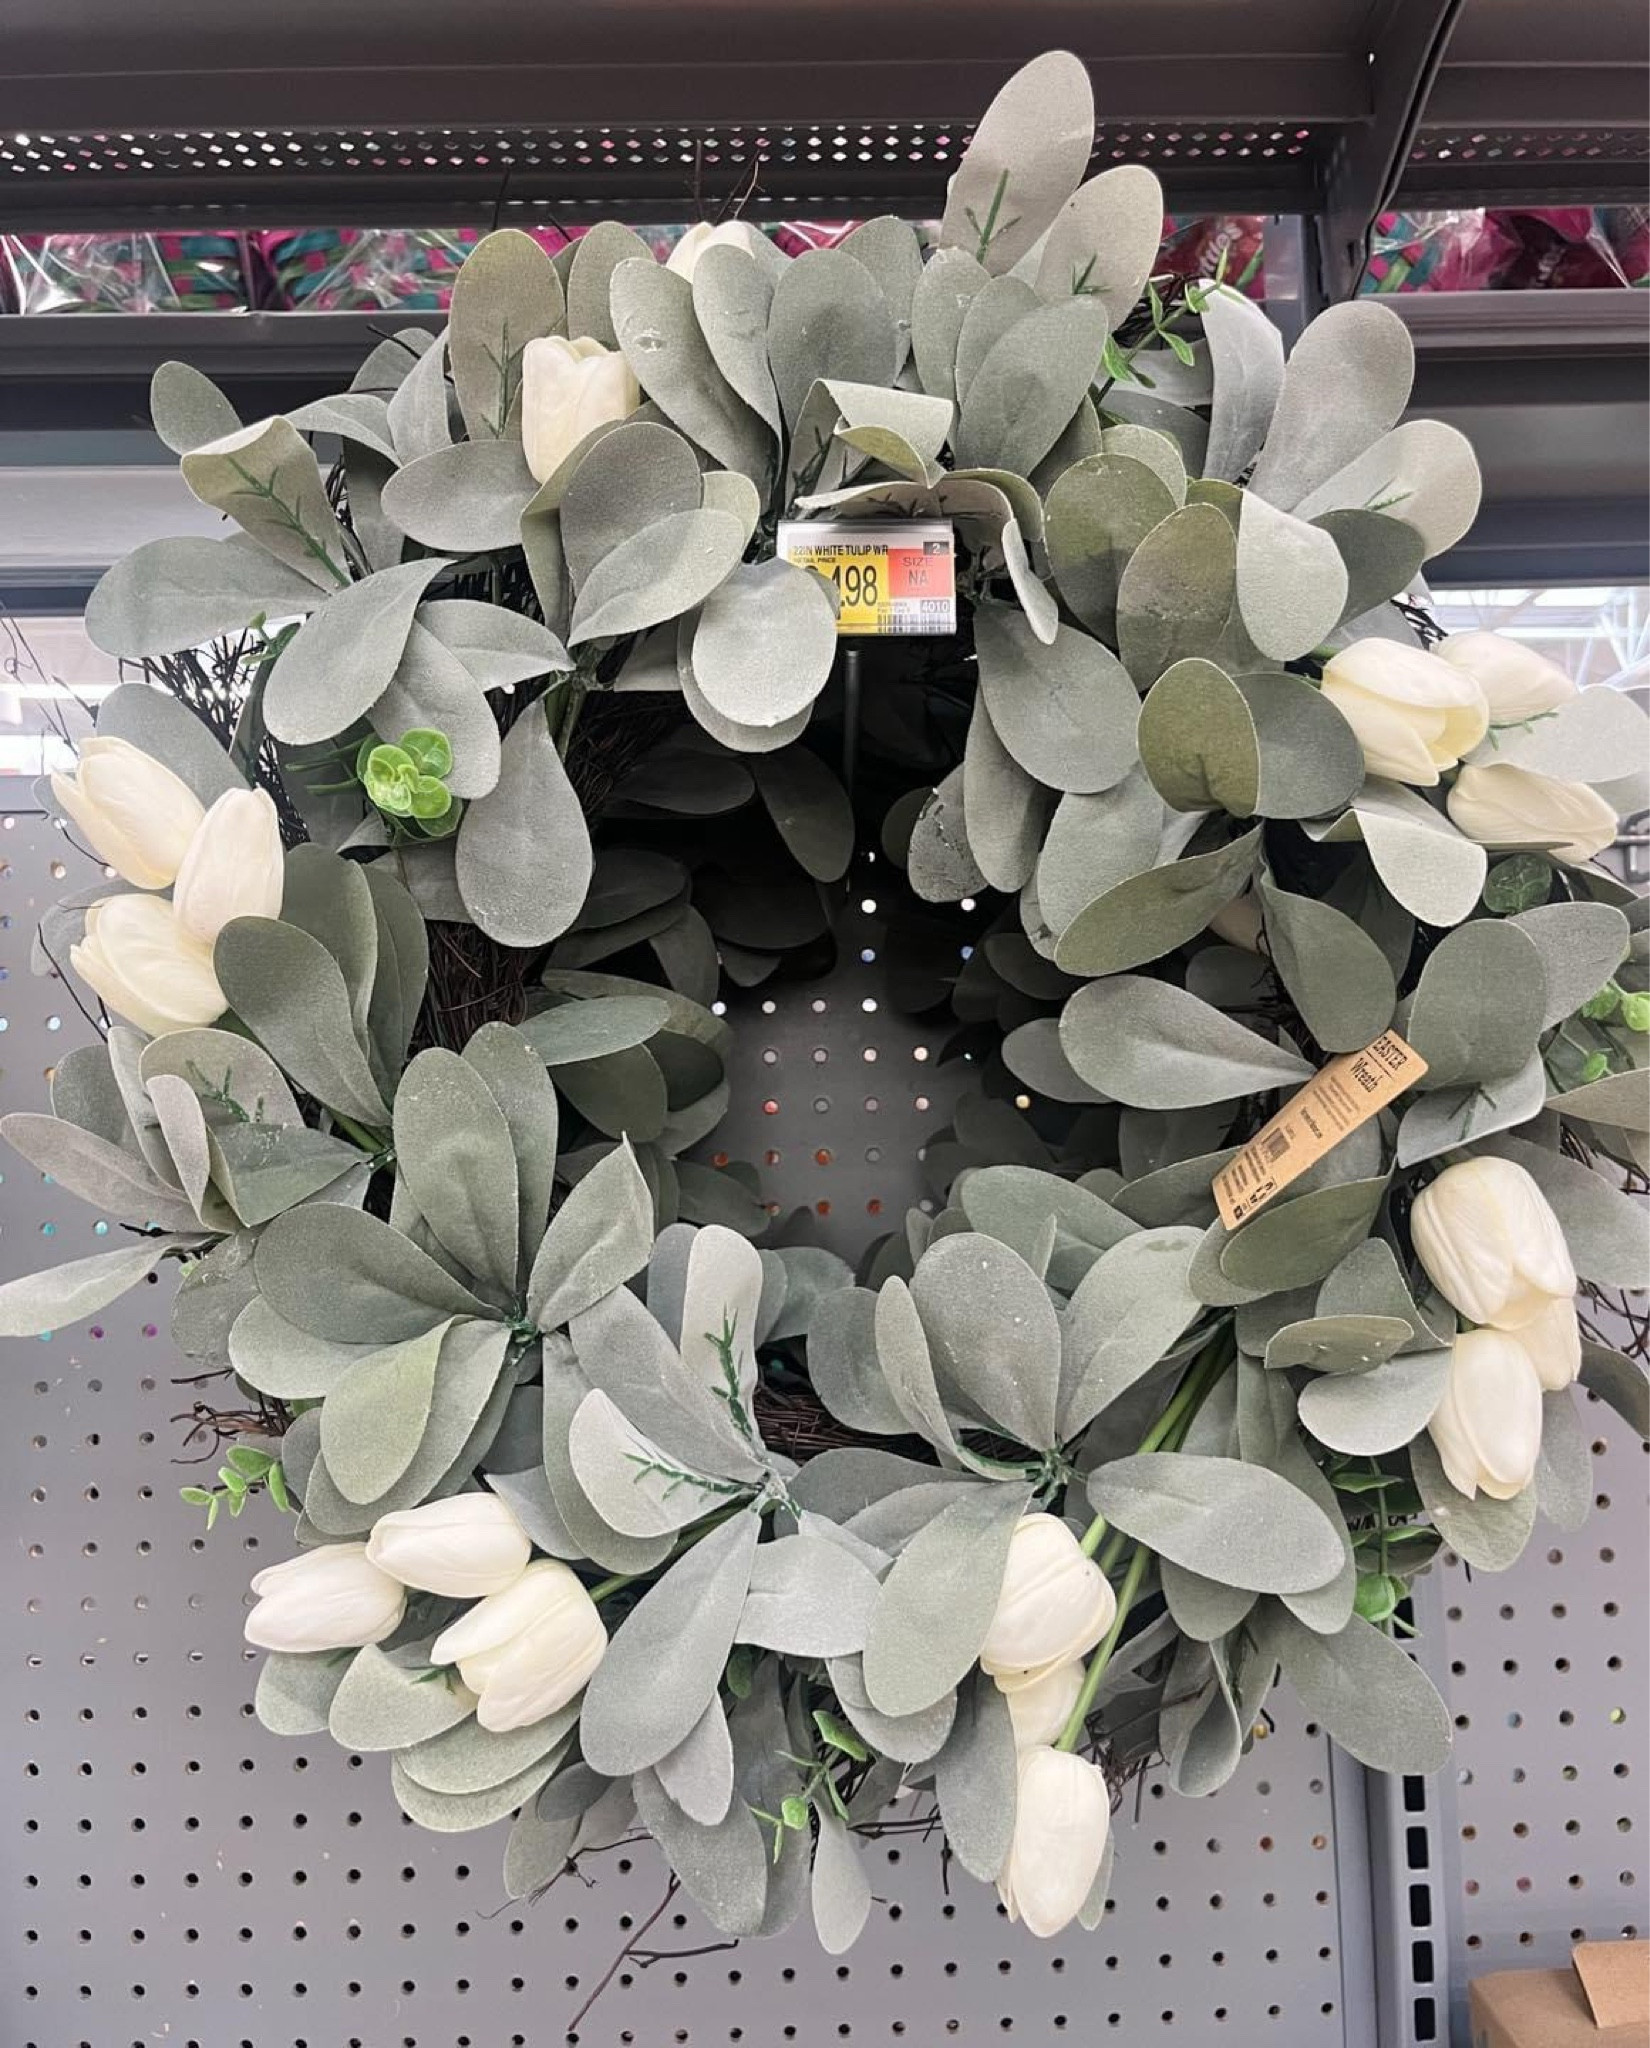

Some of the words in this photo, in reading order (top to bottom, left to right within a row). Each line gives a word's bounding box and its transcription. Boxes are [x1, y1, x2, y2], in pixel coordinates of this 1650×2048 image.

[814, 545, 844, 556] WHITE
[845, 545, 871, 556] TULIP
[873, 545, 888, 556] WR
[902, 557, 934, 567] SIZE
[908, 569, 929, 586] NA
[1371, 1036, 1408, 1071] EASTER
[1349, 1057, 1383, 1093] Wreath
